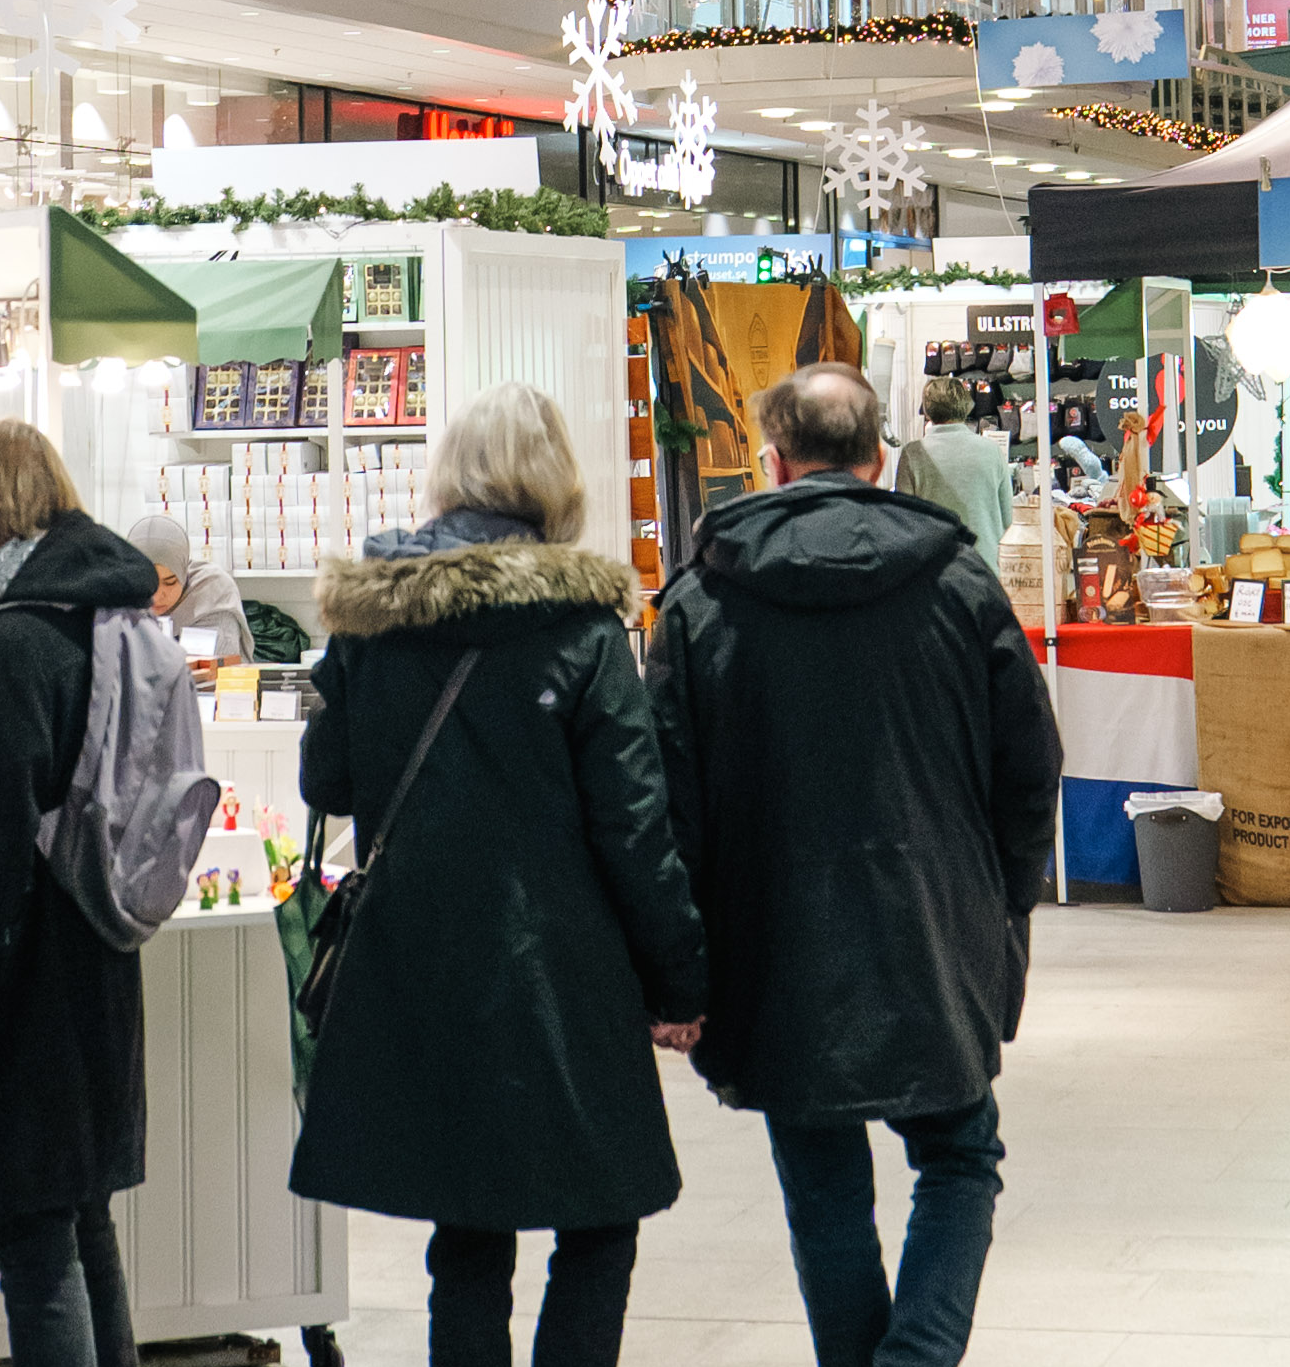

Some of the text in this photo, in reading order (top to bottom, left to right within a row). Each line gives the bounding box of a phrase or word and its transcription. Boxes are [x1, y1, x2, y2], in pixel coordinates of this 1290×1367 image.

[977, 316, 1035, 332] ULLSTR
[1108, 375, 1138, 390] The
[1197, 418, 1227, 435] you
[1231, 808, 1256, 826] FOR
[1233, 828, 1289, 849] PRODUCT
